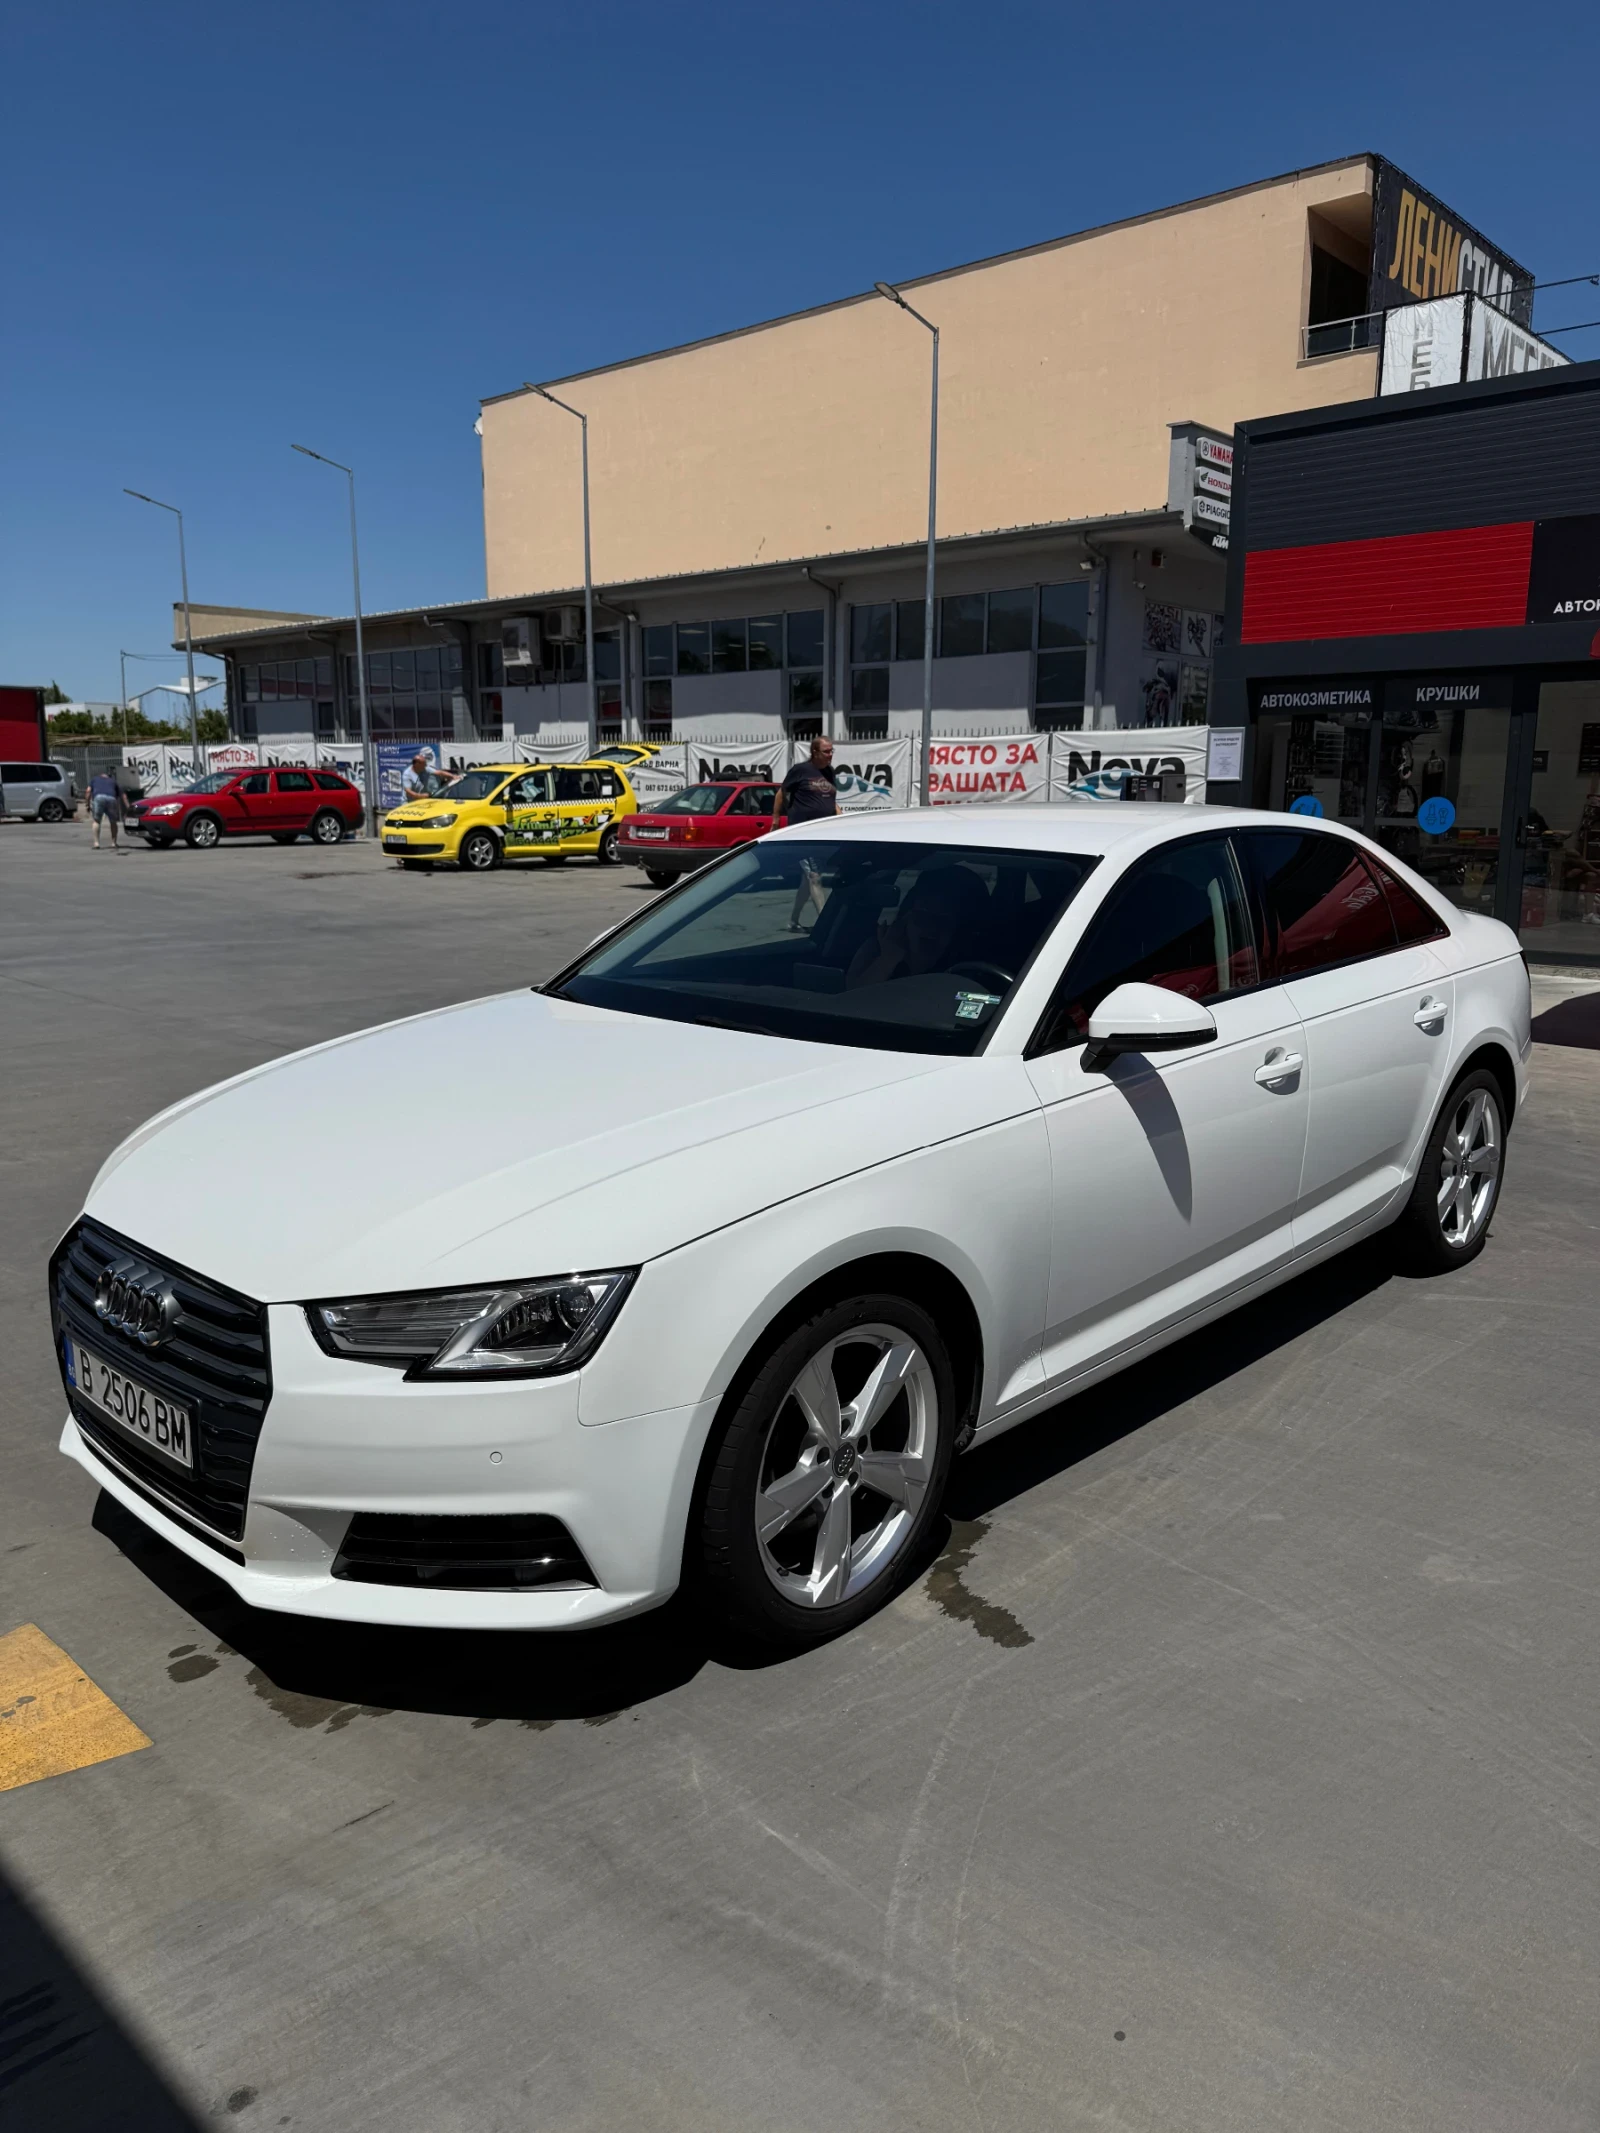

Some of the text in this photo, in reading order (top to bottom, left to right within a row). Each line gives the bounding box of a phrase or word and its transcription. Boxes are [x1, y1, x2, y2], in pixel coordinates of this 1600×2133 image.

[1212, 535, 1229, 549] KTM
[1260, 690, 1371, 708] АВТОКОЗМЕТИКА
[1416, 685, 1480, 702] КРУШКИ
[244, 750, 256, 763] ЗА
[1005, 743, 1039, 764] ЗА
[834, 764, 893, 793] ova
[928, 772, 1027, 792] ВАШАТА
[80, 1347, 187, 1460] B 2506 BM
